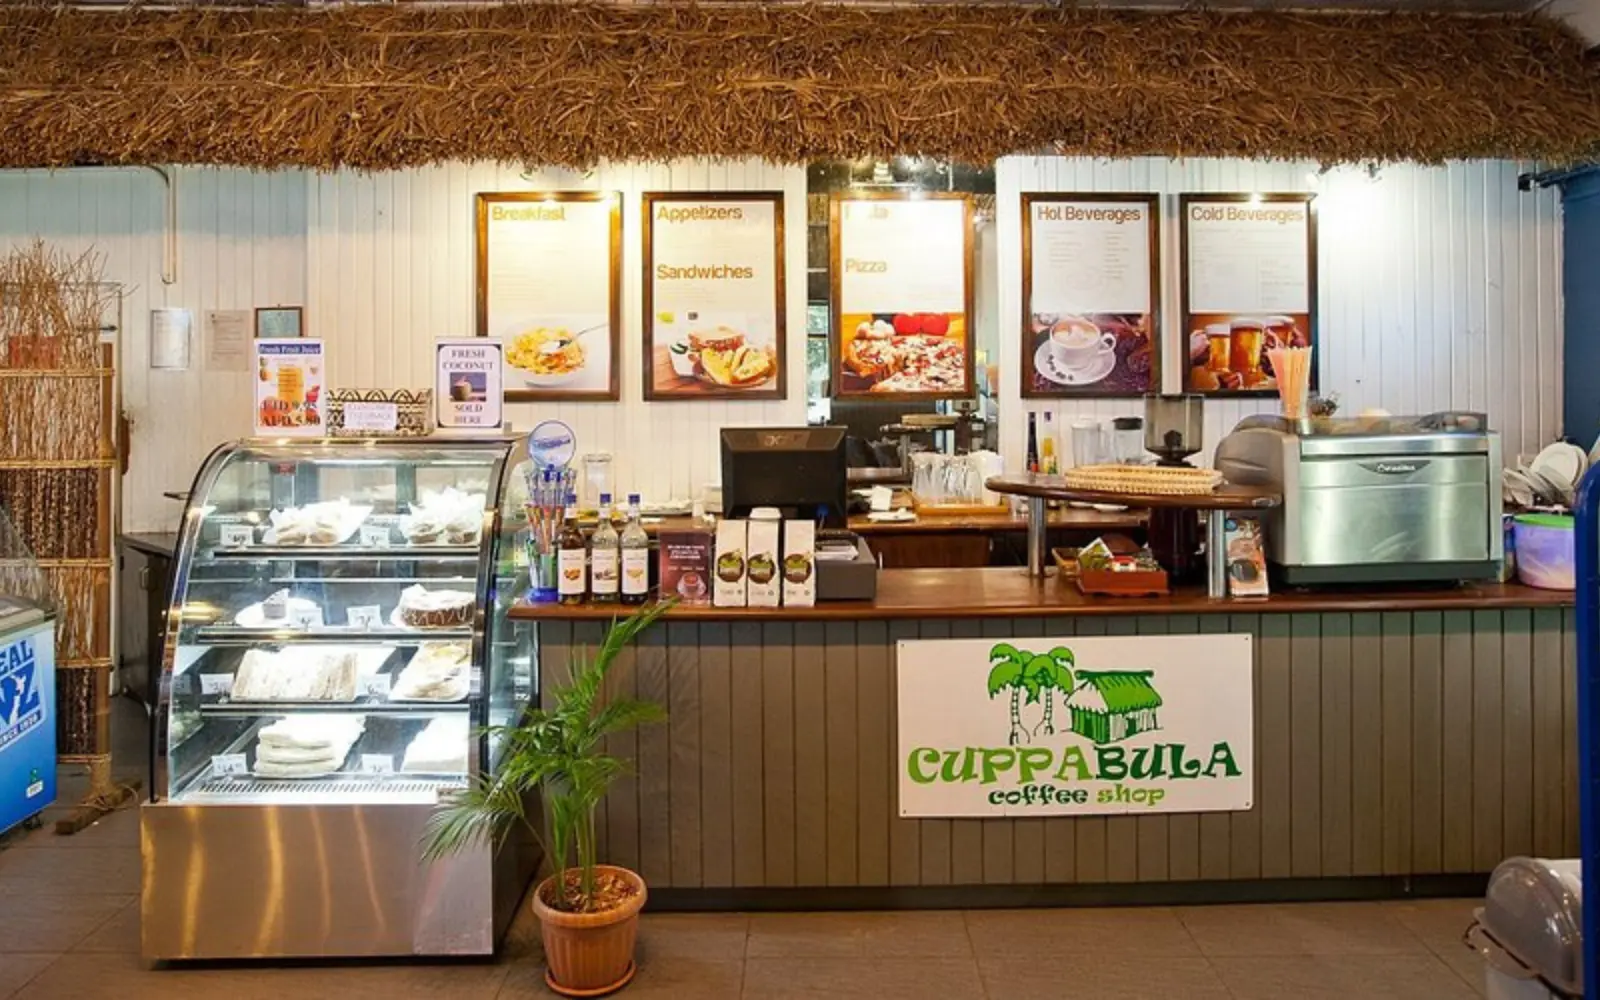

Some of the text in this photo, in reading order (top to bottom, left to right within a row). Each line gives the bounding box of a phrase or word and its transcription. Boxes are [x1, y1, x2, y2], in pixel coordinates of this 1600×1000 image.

[491, 205, 565, 221] Breakfast
[656, 205, 743, 222] Appetizers
[1037, 205, 1141, 224] Hot Beverages
[1191, 206, 1304, 224] Cold Beverages
[656, 264, 754, 279] Sandwiches
[845, 258, 887, 273] Pizza
[451, 348, 486, 359] FRESH
[442, 361, 494, 371] COCONUT
[454, 403, 484, 413] SOLD
[454, 415, 482, 425] HERE
[987, 783, 1165, 806] coffee shop
